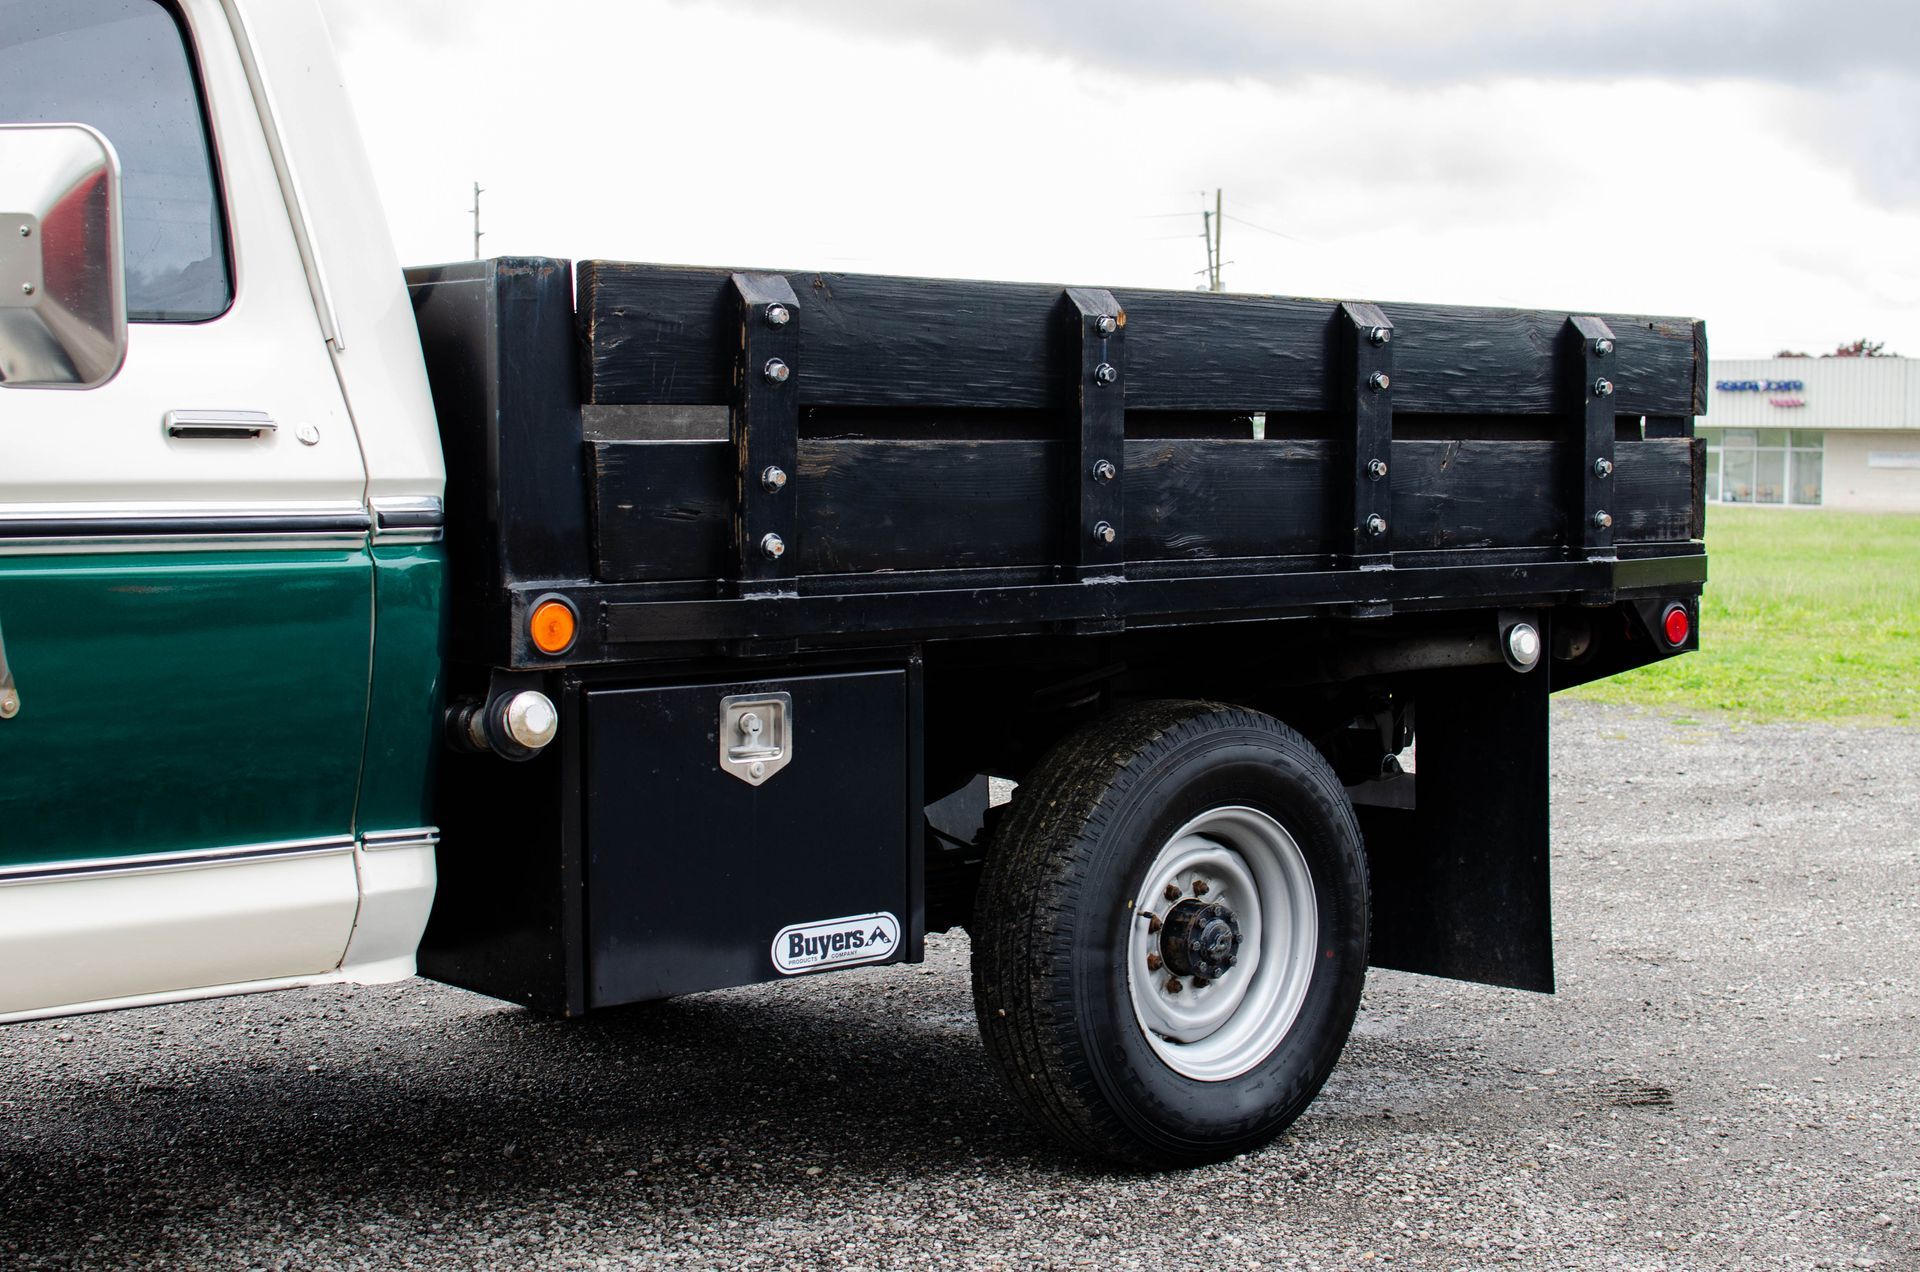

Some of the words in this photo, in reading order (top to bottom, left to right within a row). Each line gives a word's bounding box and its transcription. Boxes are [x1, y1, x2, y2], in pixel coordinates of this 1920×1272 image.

[788, 929, 864, 960] Buyers
[831, 950, 858, 959] COMPANY
[788, 956, 818, 966] PRODUCTS
